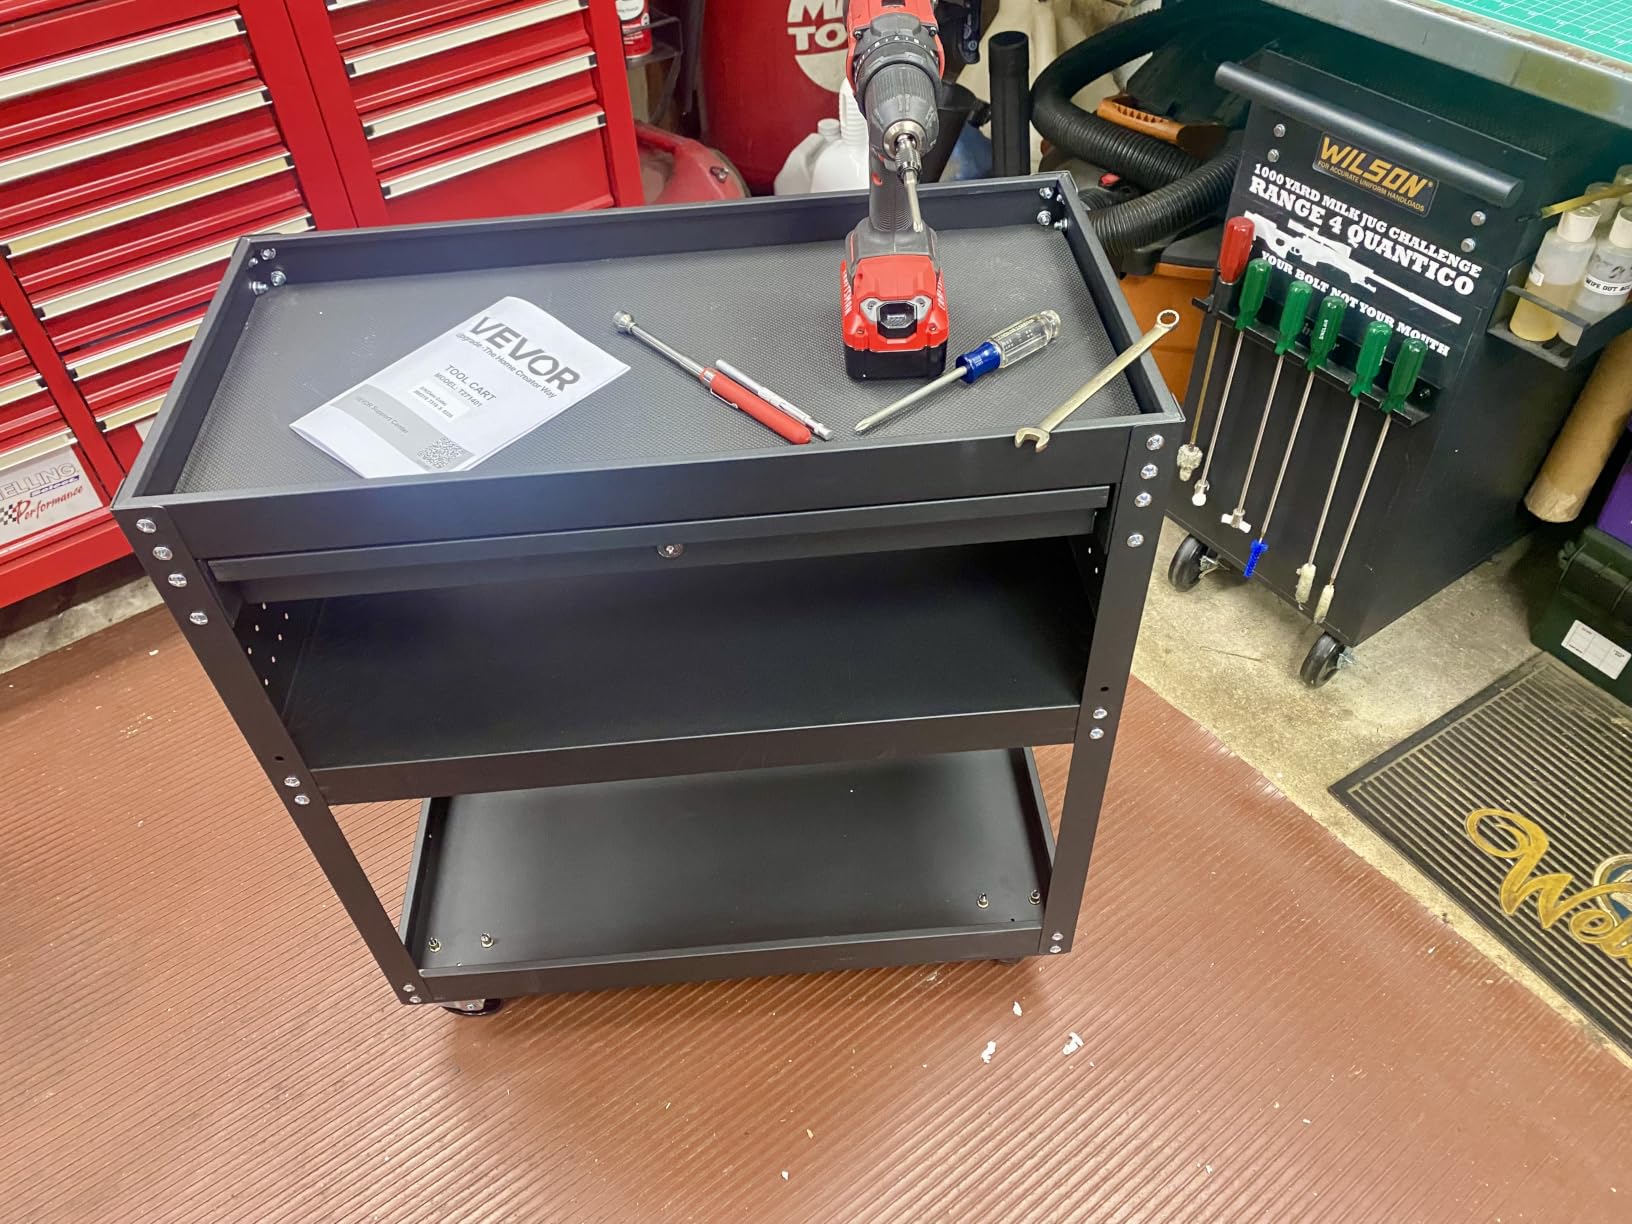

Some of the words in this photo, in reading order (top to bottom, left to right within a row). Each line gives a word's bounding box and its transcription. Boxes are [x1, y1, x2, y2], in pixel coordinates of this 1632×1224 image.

[1318, 160, 1330, 170] FOR
[1329, 166, 1359, 184] ACCURATE
[1359, 177, 1387, 196] UNIFORM
[1387, 190, 1425, 212] HANDLOADS
[1321, 137, 1428, 198] WILSON
[1249, 175, 1326, 226] RANGE
[1328, 215, 1344, 235] 4
[1347, 224, 1475, 296] QUANTICO
[1254, 163, 1284, 185] 1000
[1284, 177, 1321, 202] YARD
[1321, 194, 1361, 221] MILK
[1360, 213, 1387, 233] JUG
[1388, 226, 1483, 279] CHALLENGE
[1261, 250, 1294, 275] YOUR
[1294, 268, 1330, 293] BOLT
[1329, 286, 1359, 308] NOT
[1359, 301, 1395, 329] YOUR
[1396, 321, 1451, 357] MOUTH
[470, 316, 581, 392] VEVOR
[495, 353, 517, 372] Home
[515, 369, 542, 389] Creator
[540, 385, 558, 399] Way
[445, 364, 469, 384] TOOL
[468, 382, 497, 401] CART
[0, 463, 77, 500] ELLING
[12, 485, 83, 524] Performance
